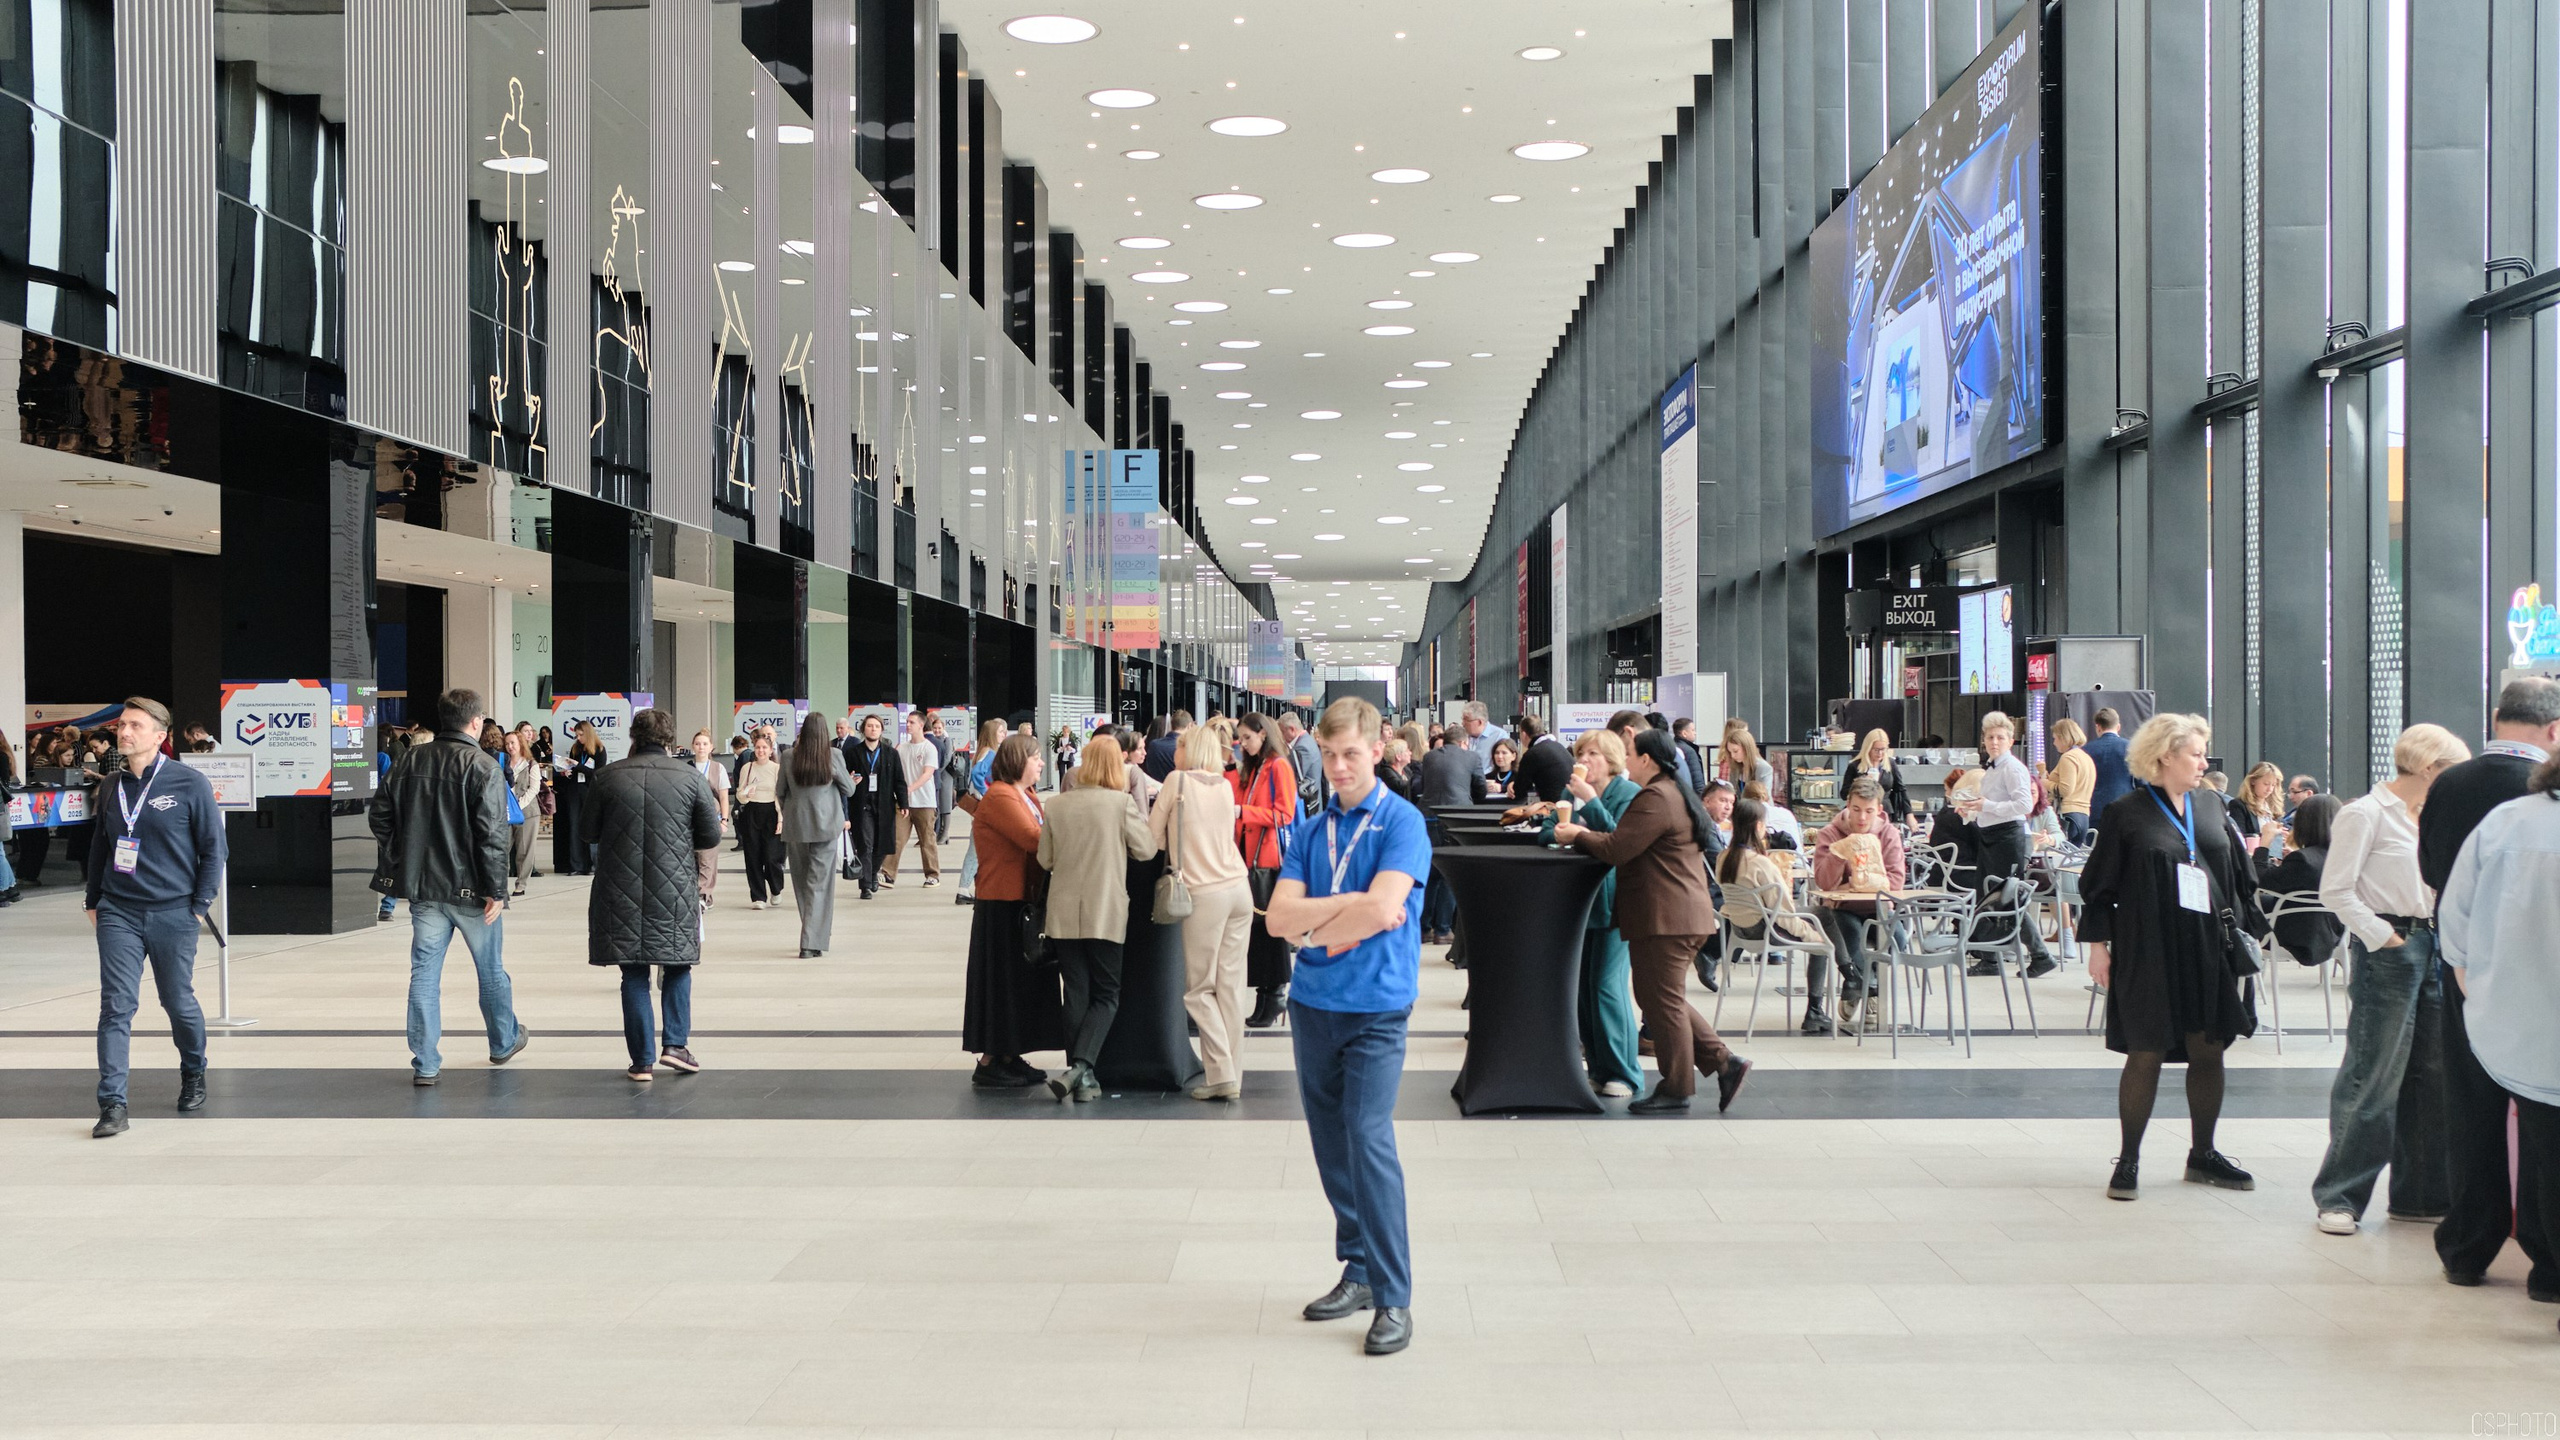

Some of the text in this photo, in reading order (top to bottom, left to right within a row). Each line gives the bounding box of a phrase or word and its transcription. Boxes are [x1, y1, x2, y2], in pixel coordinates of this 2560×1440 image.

[1955, 200, 2017, 265] 30 лет опыта
[1955, 218, 2024, 297] в выставочной
[1955, 273, 2005, 327] индустрии
[1124, 455, 1142, 483] F
[1117, 518, 1140, 527] G H
[1114, 534, 1144, 543] G20-29
[1114, 560, 1145, 569] H20-29
[1893, 594, 1928, 608] EXIT
[1886, 610, 1936, 627] ВЫХОД
[1270, 622, 1278, 634] G
[538, 635, 549, 653] 20
[1615, 667, 1638, 676] ВЫХОД
[1122, 700, 1137, 710] 23
[269, 712, 312, 728] КУБ
[586, 716, 616, 727] КУБ
[760, 717, 784, 727] КУБ
[68, 793, 83, 804] 2-4
[67, 810, 83, 818] 2025
